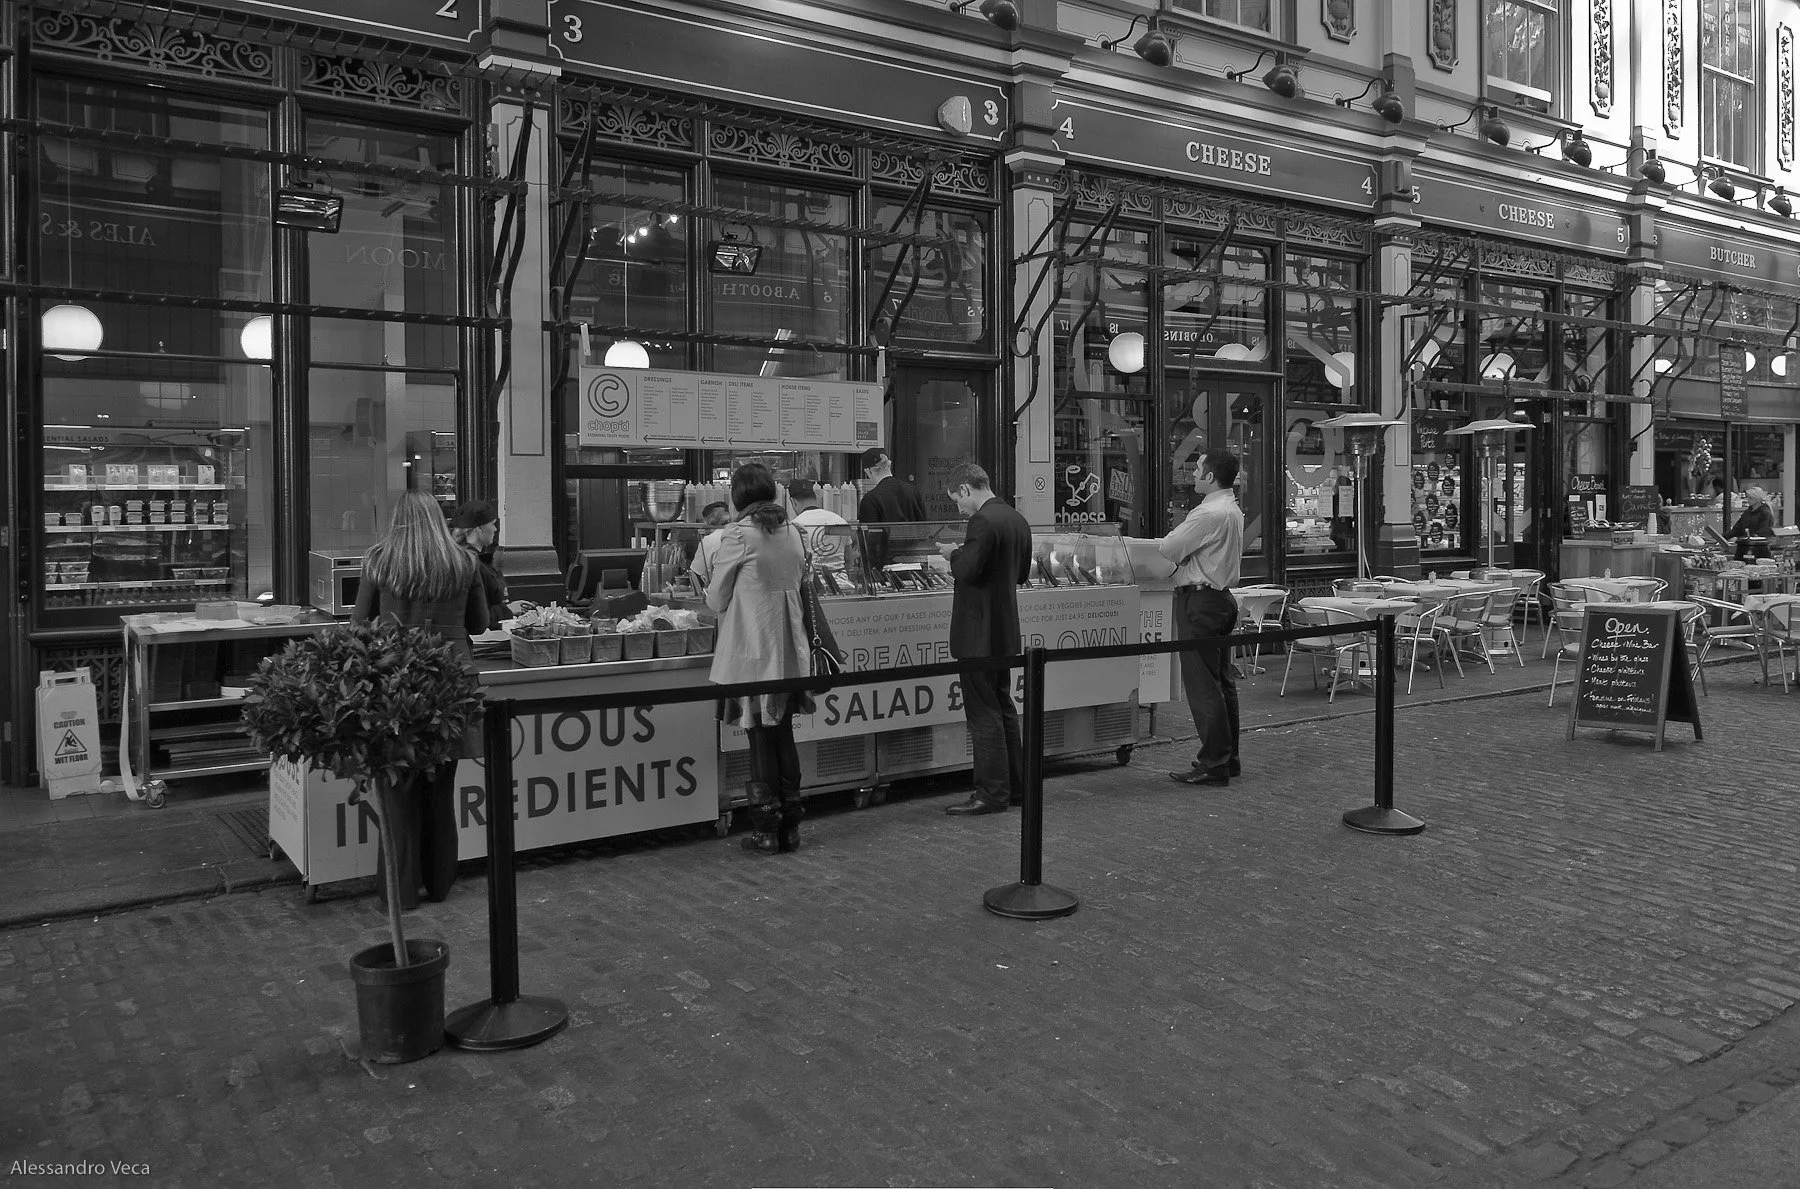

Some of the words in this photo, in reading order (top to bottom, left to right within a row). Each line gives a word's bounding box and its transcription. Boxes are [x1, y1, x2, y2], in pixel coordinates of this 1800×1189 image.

[562, 15, 583, 43] 3
[983, 101, 999, 126] 3
[1060, 117, 1075, 140] 4
[1186, 141, 1272, 177] CHEESE
[1361, 177, 1372, 195] 4
[1411, 186, 1421, 204] 5
[1498, 203, 1556, 229] CHEESE
[1617, 228, 1625, 243] 5
[1710, 246, 1757, 269] BUTCHER
[1024, 604, 1033, 612] OF
[1057, 601, 1083, 609] VEGGIES
[856, 615, 871, 624] ANY
[872, 614, 883, 623] OF
[884, 613, 899, 622] OUR
[900, 612, 905, 621] 7
[906, 611, 926, 620] BASES
[1041, 614, 1053, 622] FOR
[1054, 613, 1068, 621] JUST
[847, 629, 862, 637] DELI
[883, 626, 897, 634] ANY
[899, 624, 931, 633] DRESSING
[840, 641, 949, 673] REATE
[824, 685, 934, 726] SALAD
[53, 718, 86, 729] CAUTION
[534, 705, 656, 756] IOUS
[55, 756, 69, 765] WET
[69, 754, 89, 763] FLOOR
